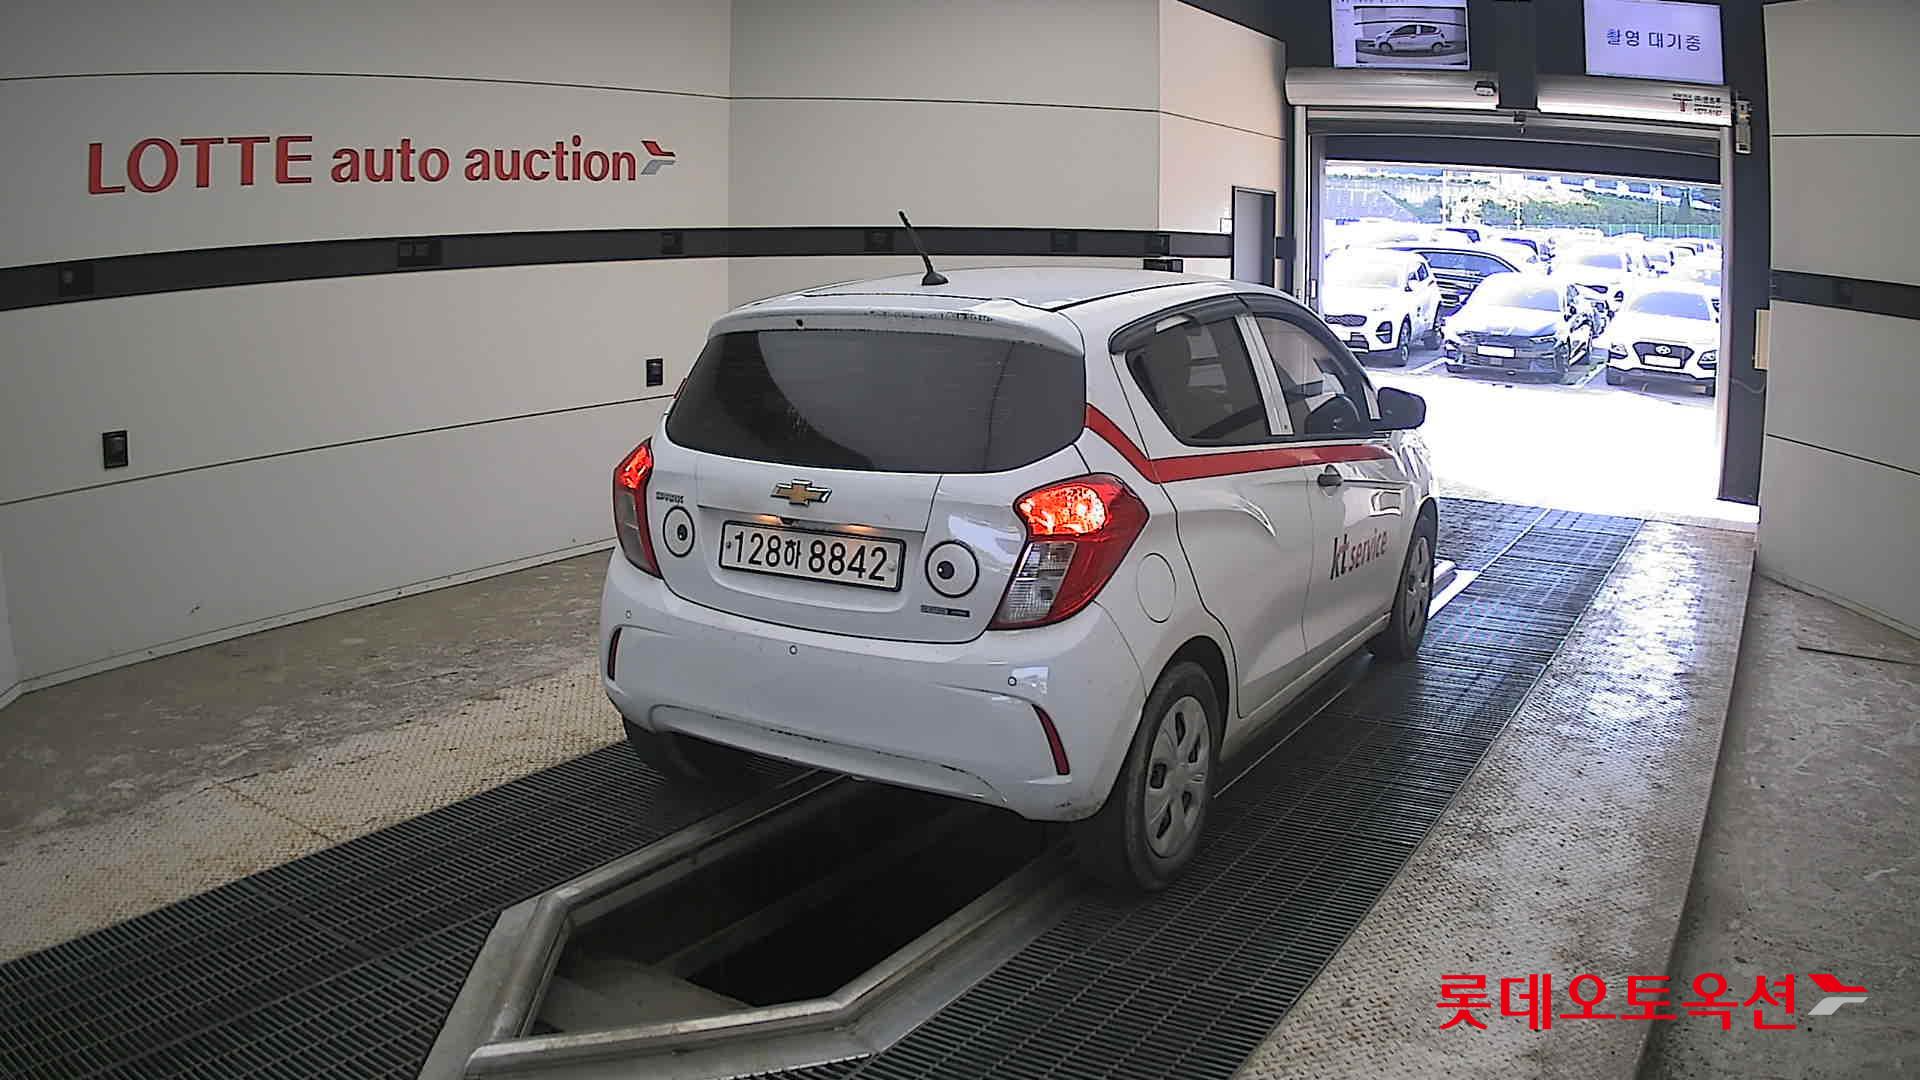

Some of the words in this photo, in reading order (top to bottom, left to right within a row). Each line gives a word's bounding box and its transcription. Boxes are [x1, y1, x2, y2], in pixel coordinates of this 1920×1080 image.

[1648, 31, 1701, 52] 대기중
[88, 135, 313, 195] LOTTE
[330, 138, 450, 183] auto
[464, 135, 637, 182] auction
